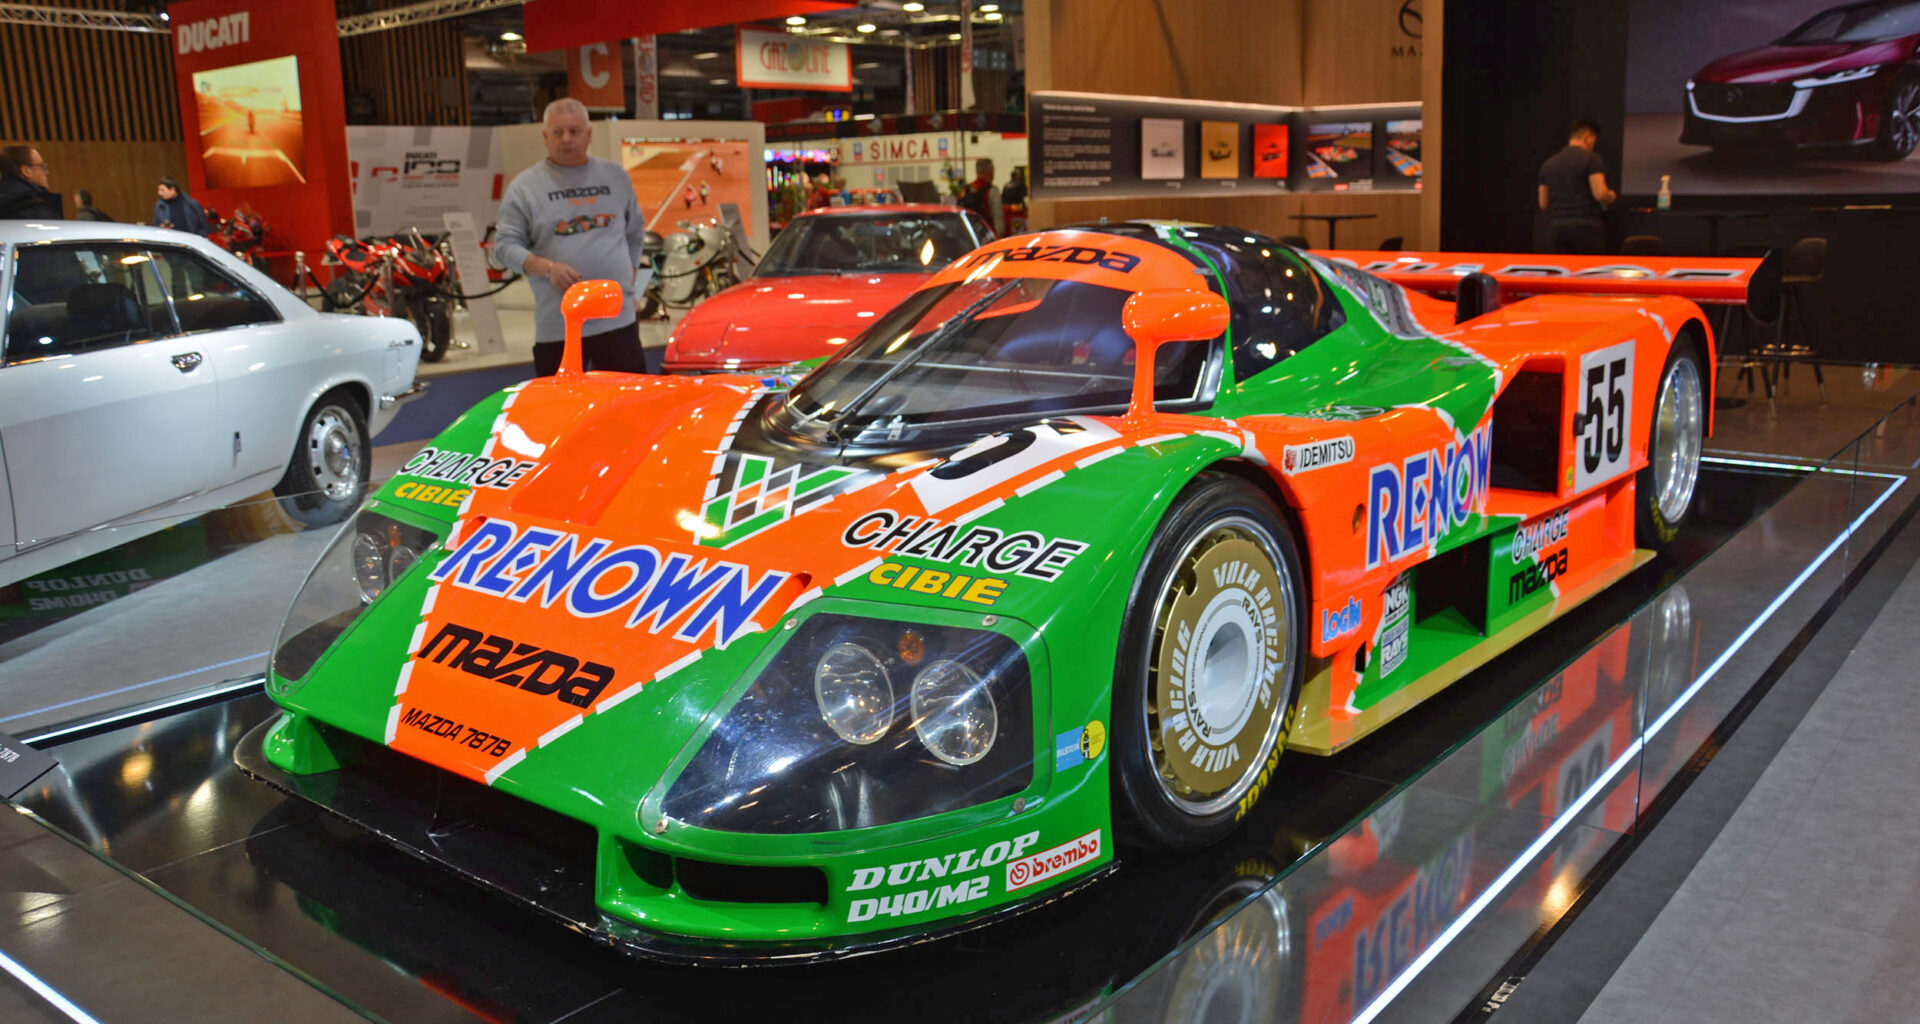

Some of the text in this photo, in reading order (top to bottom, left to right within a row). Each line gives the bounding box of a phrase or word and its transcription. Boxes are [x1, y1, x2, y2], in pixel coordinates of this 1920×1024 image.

[178, 11, 250, 55] DUCATI
[1391, 45, 1424, 58] MA
[870, 138, 931, 160] SIMCA
[1584, 357, 1627, 474] 55
[396, 447, 540, 491] CHARGE
[1300, 439, 1353, 469] IDEMITSU
[841, 508, 1090, 582] CHARGE
[1512, 507, 1570, 565] CHARGE
[427, 517, 792, 651] RENOWN
[1213, 560, 1261, 592] VOLK
[1385, 577, 1409, 617] NGK
[1241, 596, 1263, 644] RAYS
[401, 708, 512, 758] MAZDA 787B
[1187, 690, 1212, 738] RAYS
[846, 830, 1040, 891] DUNLOP
[1032, 837, 1099, 878] brembo
[847, 875, 990, 923] D40/M2
